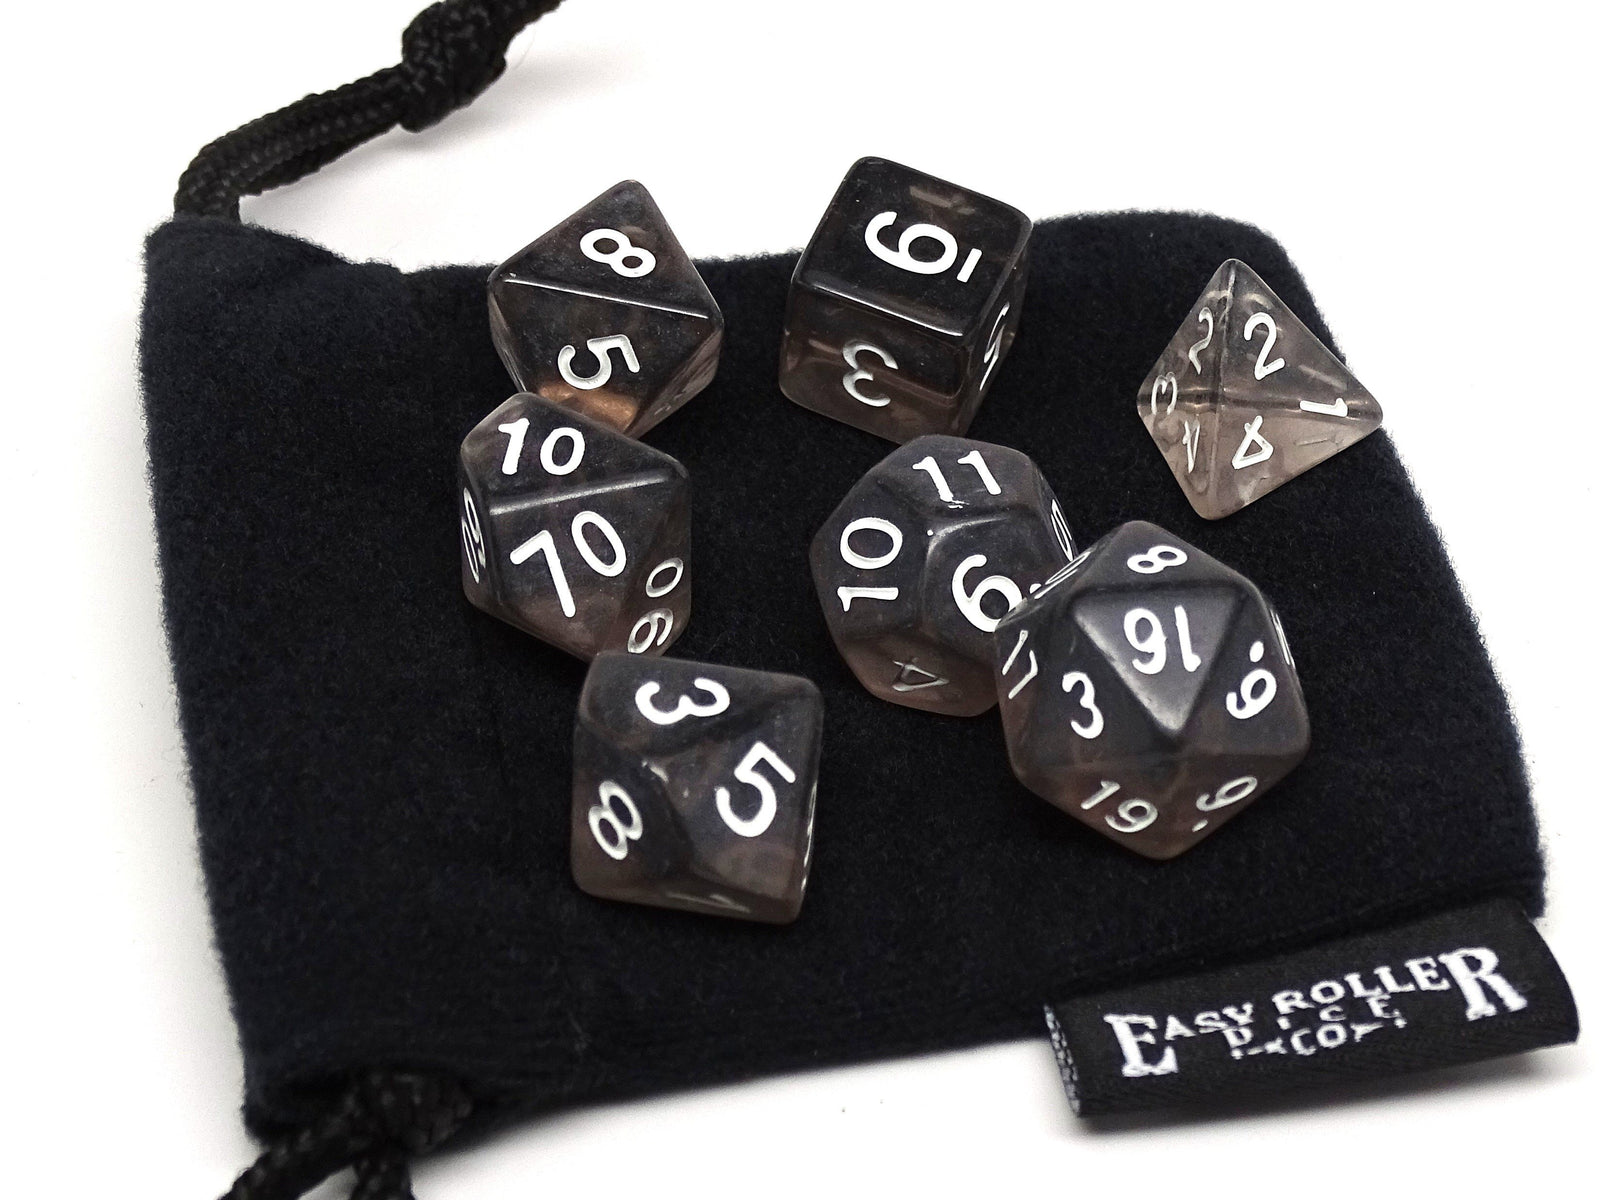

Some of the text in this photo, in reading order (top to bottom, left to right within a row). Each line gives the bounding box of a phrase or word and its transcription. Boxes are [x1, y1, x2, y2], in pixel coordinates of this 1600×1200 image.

[579, 228, 657, 278] 8
[557, 333, 641, 390] 5
[841, 339, 899, 407] 3
[1243, 311, 1286, 381] 2
[1299, 397, 1349, 418] 1
[497, 417, 586, 475] 10
[1231, 415, 1274, 470] 4
[912, 450, 1002, 502] 11
[509, 510, 627, 618] 70
[836, 516, 904, 612] 10
[1126, 545, 1188, 575] 8
[1123, 605, 1202, 675] 16
[634, 676, 731, 726] 3
[1061, 671, 1105, 740] 3
[587, 778, 644, 861] 8
[714, 740, 797, 838] 5
[1080, 779, 1159, 833] 19
[1104, 946, 1528, 1077] EASY ROLLER
